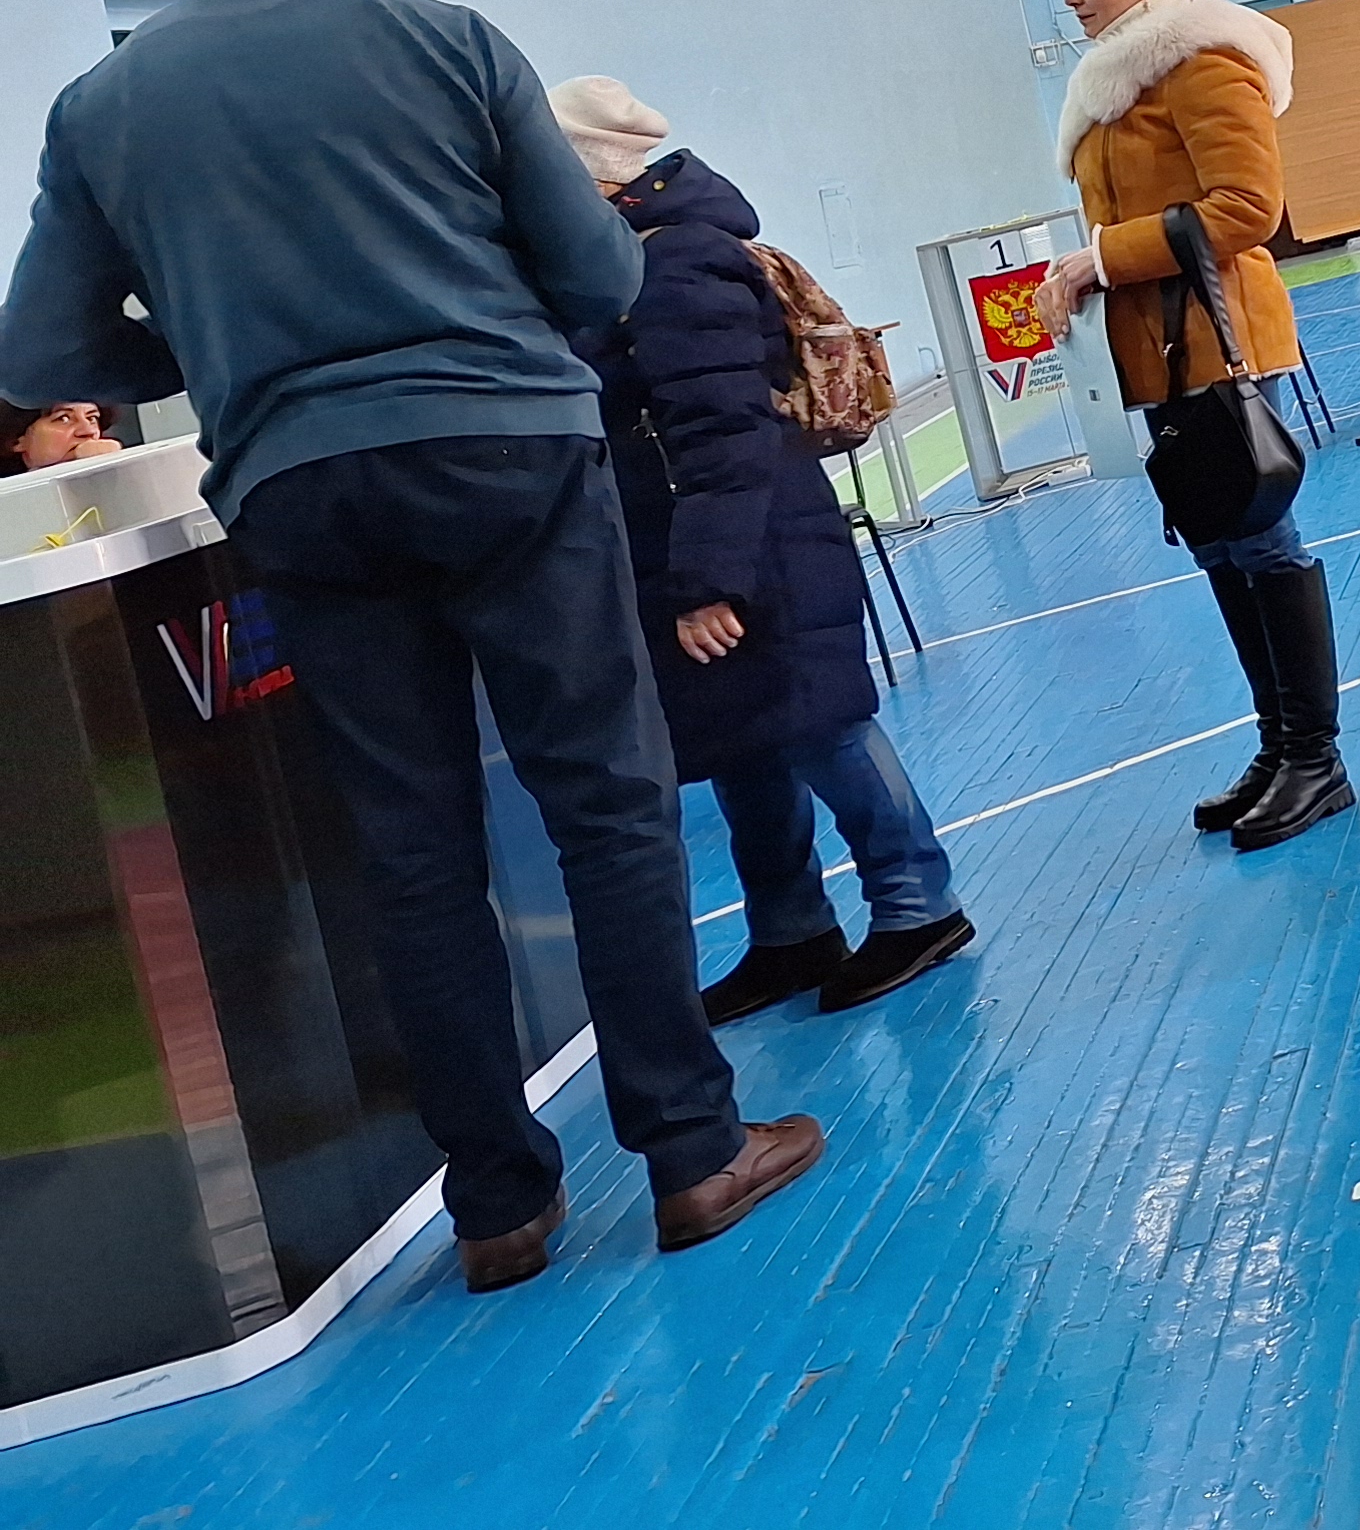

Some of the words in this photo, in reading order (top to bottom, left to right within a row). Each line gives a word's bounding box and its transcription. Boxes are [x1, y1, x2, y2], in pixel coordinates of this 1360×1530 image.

[990, 239, 1014, 271] 1
[1032, 353, 1060, 367] ВЫБО
[1030, 362, 1064, 377] ПРЕЗИ
[1028, 372, 1063, 388] РОССИИ
[1045, 381, 1066, 392] МАРТА
